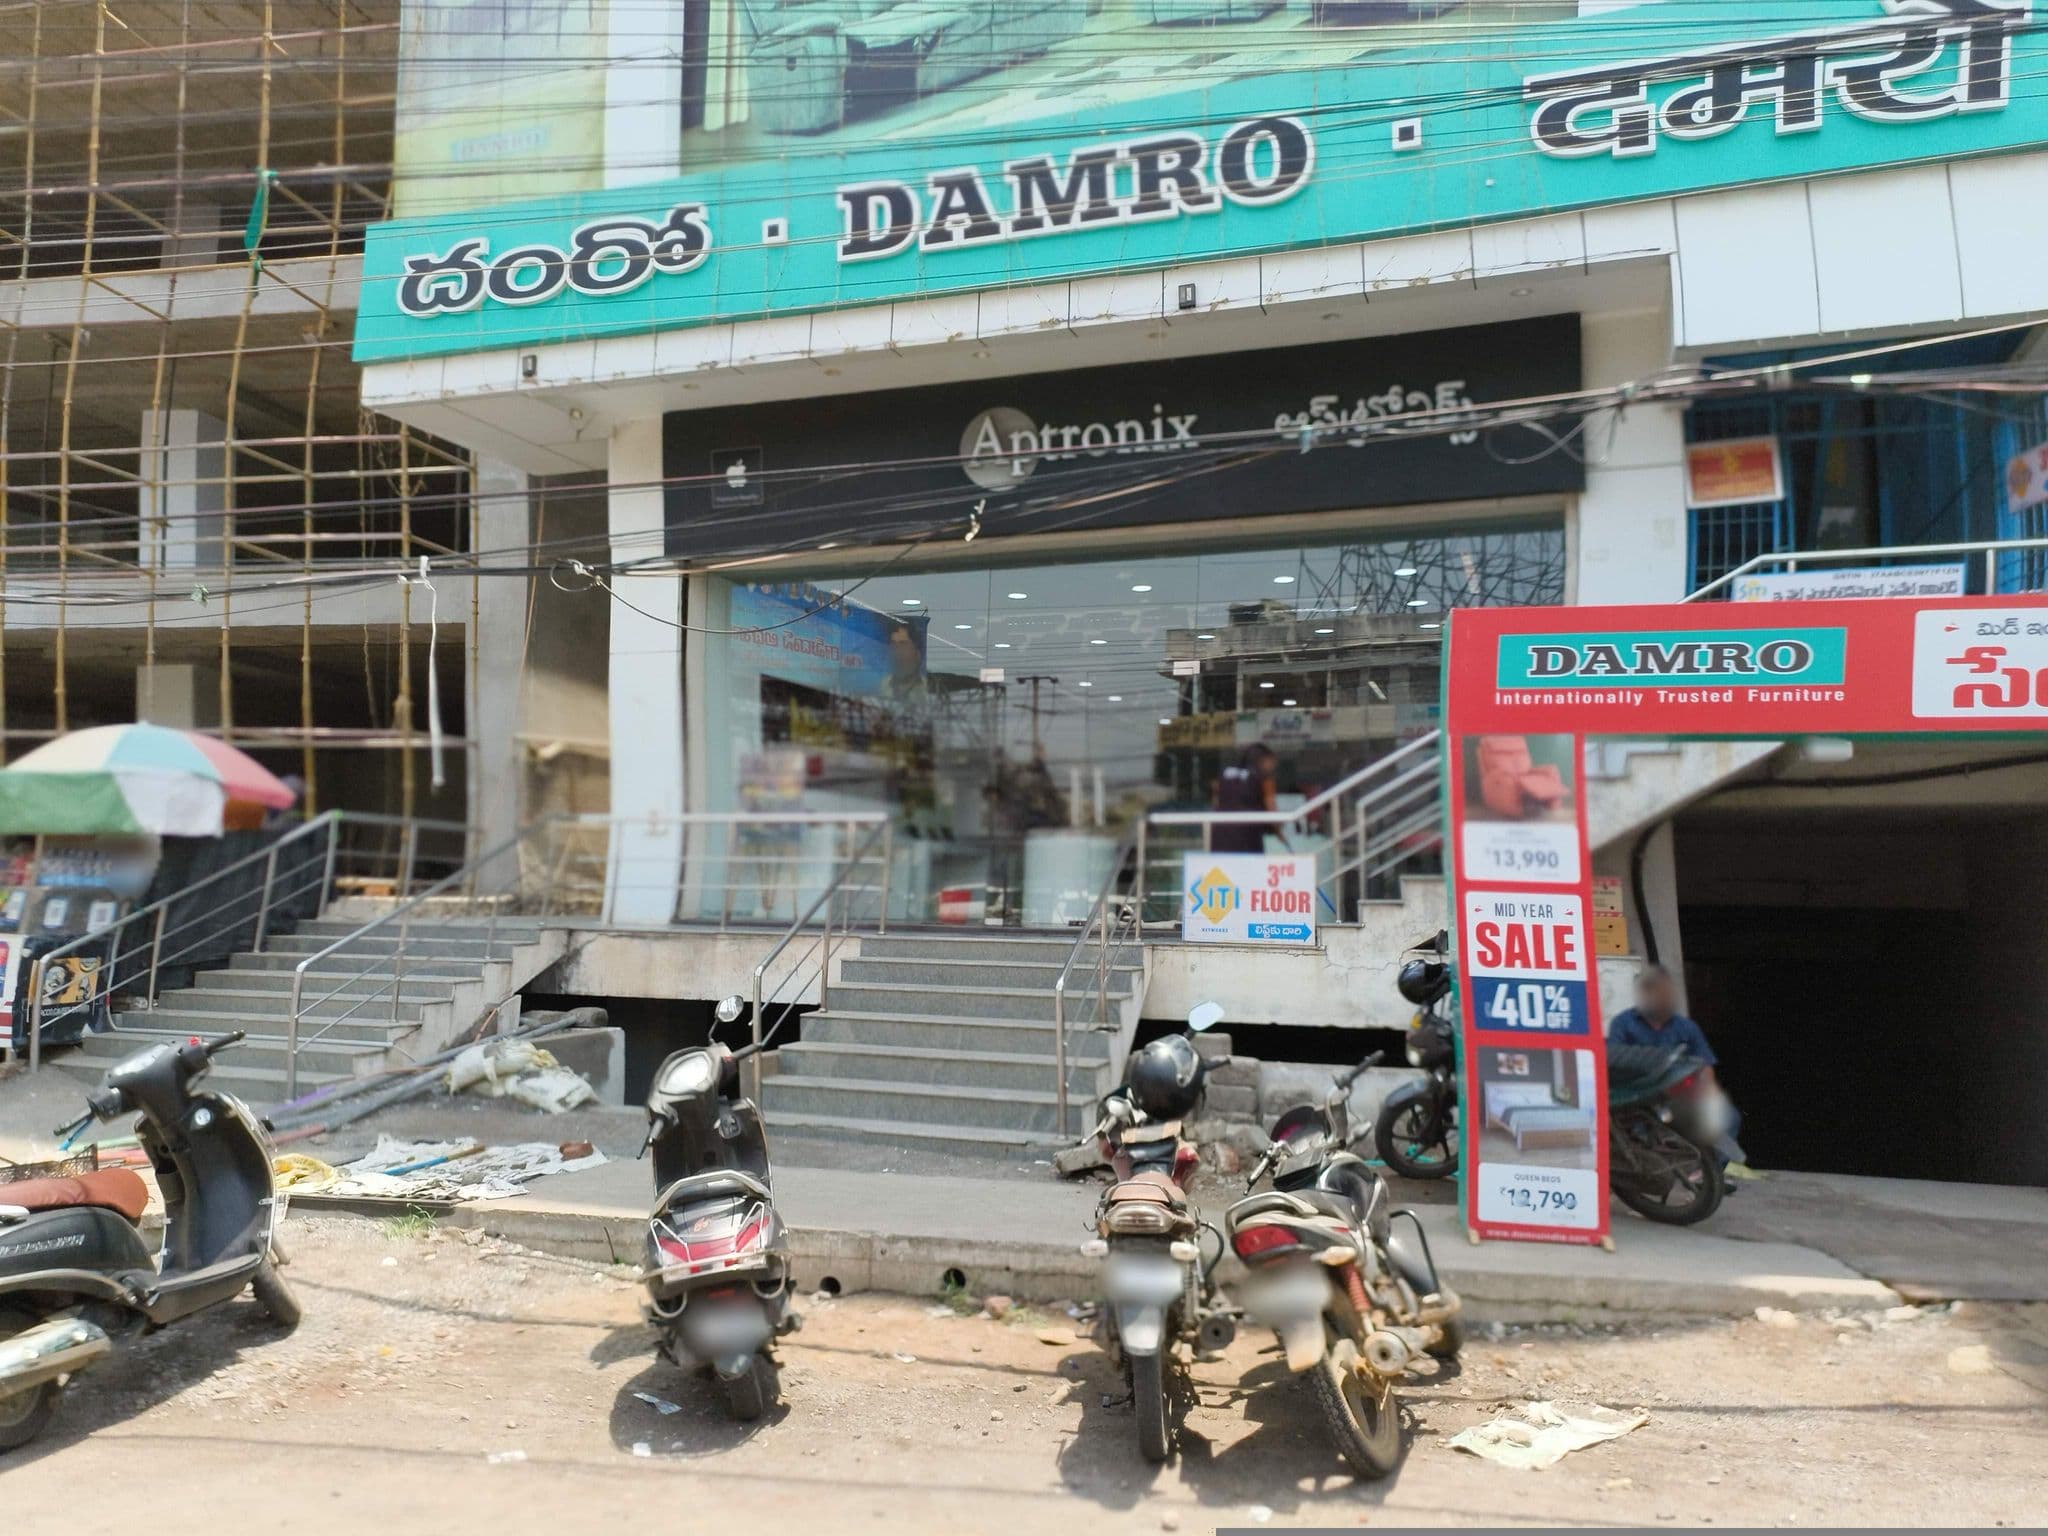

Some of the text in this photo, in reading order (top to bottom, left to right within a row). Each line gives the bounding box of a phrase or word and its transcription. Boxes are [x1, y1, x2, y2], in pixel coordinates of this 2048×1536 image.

[837, 115, 1315, 263] DAMRO
[970, 403, 1199, 476] Aptronix
[1526, 639, 1814, 678] DAMRO
[1495, 687, 1845, 707] Internationally Trusted Furniture
[1267, 862, 1296, 888] 3rd
[1250, 888, 1312, 914] FLOOR
[1494, 902, 1553, 919] MID YEAR
[1475, 921, 1577, 970] SALE
